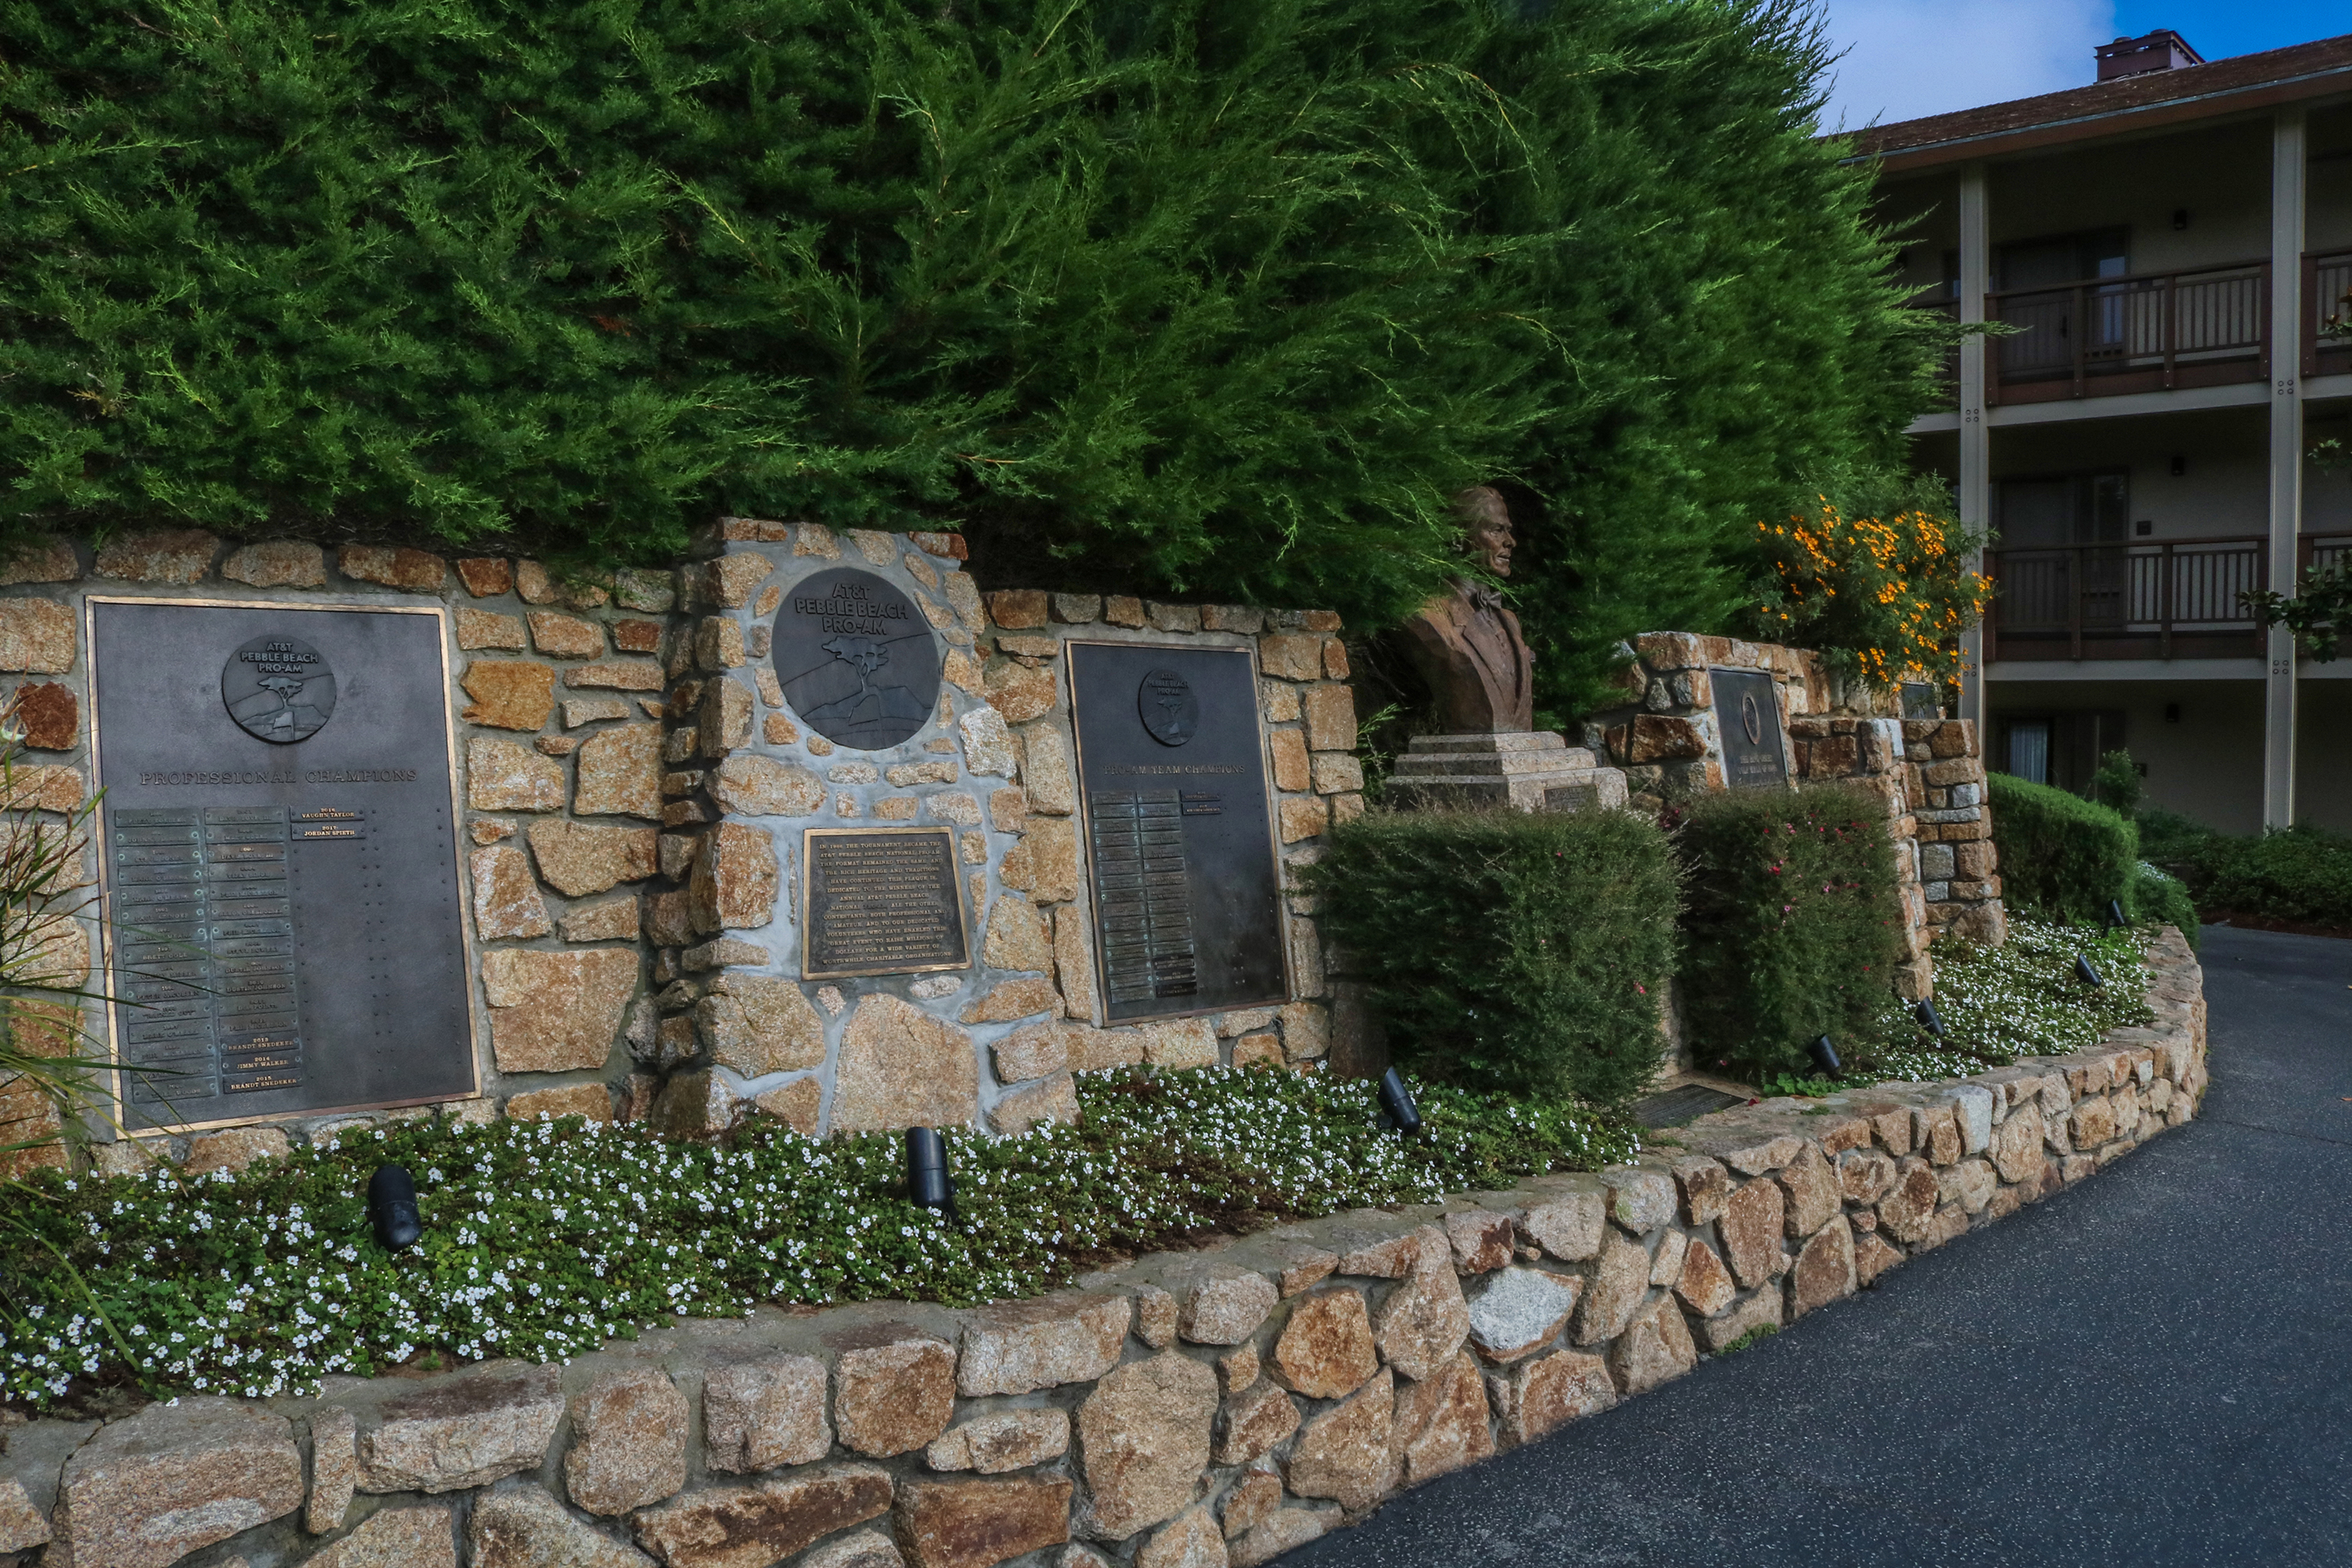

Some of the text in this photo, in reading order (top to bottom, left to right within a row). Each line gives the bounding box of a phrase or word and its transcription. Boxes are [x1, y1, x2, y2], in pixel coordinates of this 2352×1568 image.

[833, 582, 870, 600] AT&T
[794, 598, 908, 619] PEBBLE BEACH
[822, 616, 887, 636] PRO-AM
[267, 642, 292, 652] AT&T
[241, 652, 318, 664] PEBBLE BEACH
[258, 662, 303, 673] PRO-AM
[1103, 764, 1245, 775] PRO-AM TEAM CHAMPIONS
[140, 768, 418, 786] PROFESSIONAL CHAMPIONS
[822, 956, 864, 965] WORTHWHILE
[257, 1040, 294, 1049] SNEDEKER
